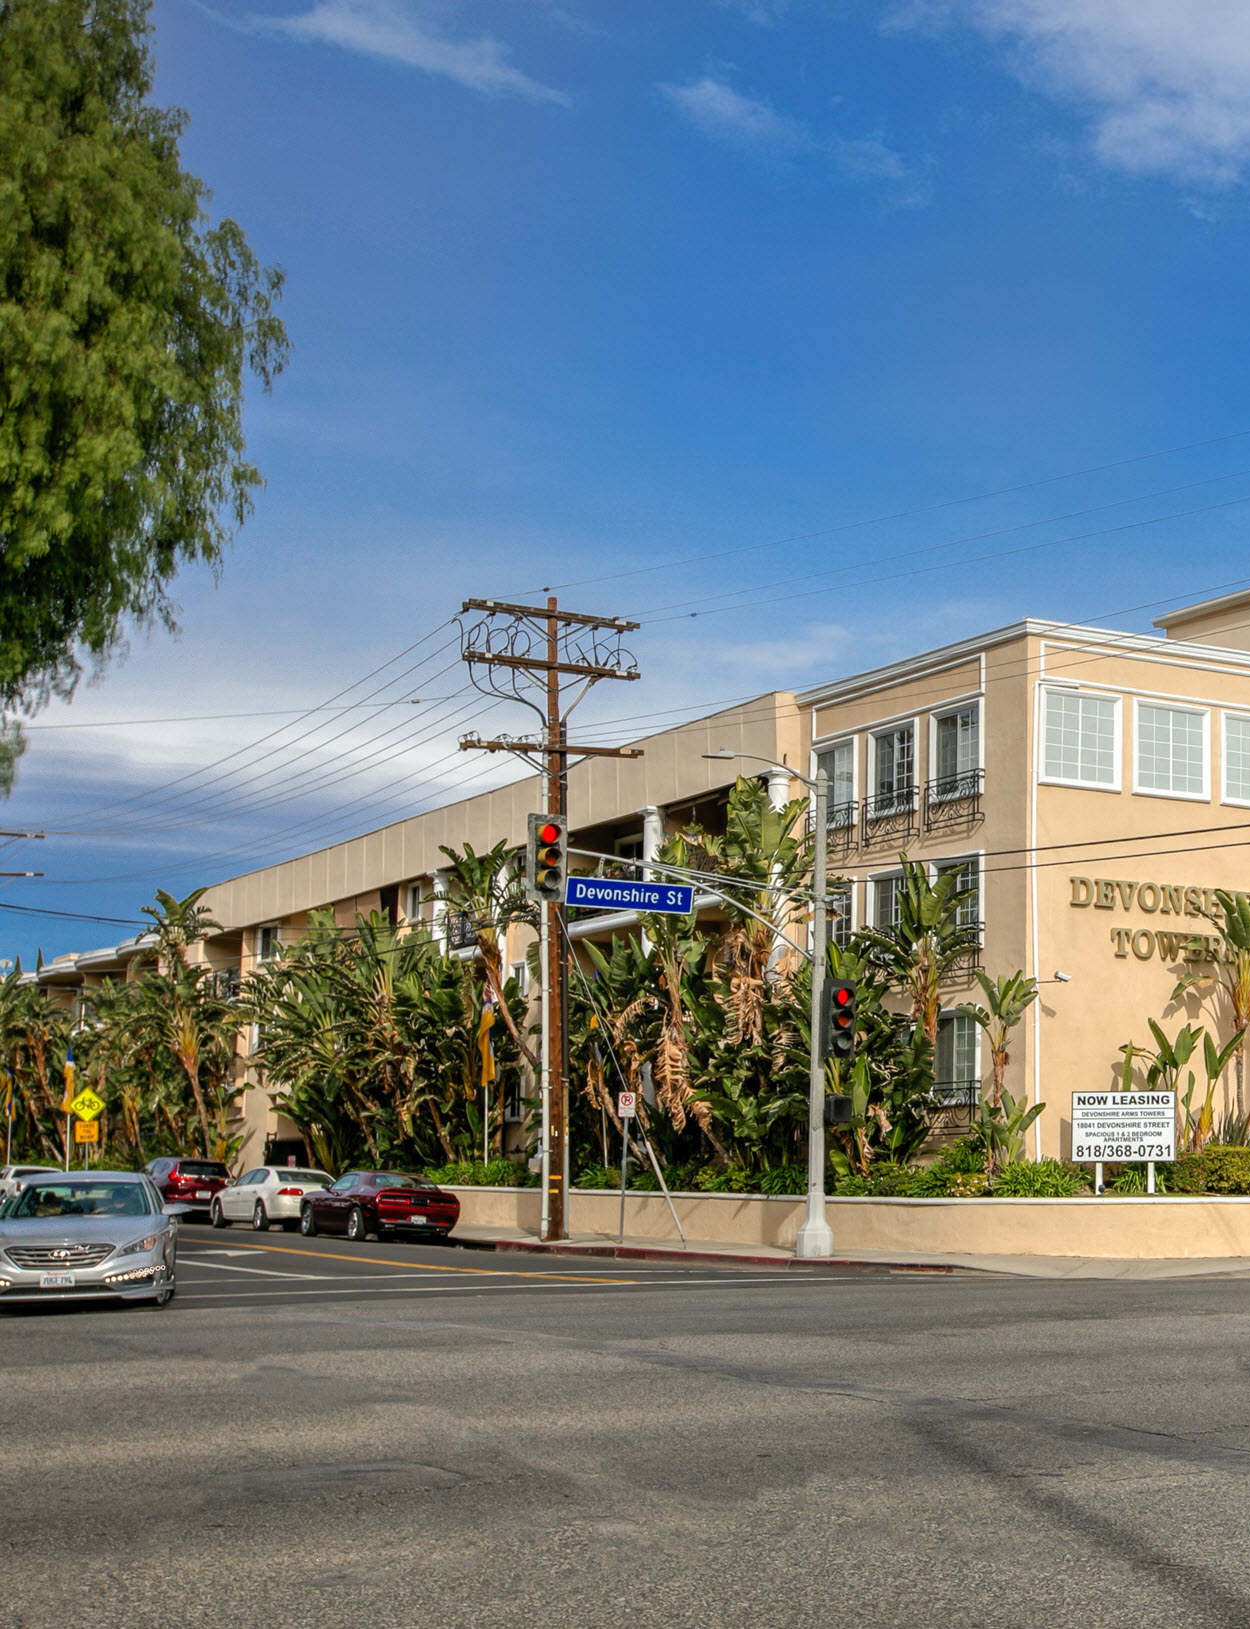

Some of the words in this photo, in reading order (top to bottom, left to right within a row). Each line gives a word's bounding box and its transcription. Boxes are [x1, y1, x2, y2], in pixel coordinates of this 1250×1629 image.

[576, 884, 659, 903] Devonshire
[666, 891, 683, 905] St
[1077, 1096, 1108, 1105] NOW
[1112, 1095, 1170, 1105] LEASING
[1076, 1145, 1171, 1158] 818/368-0731
